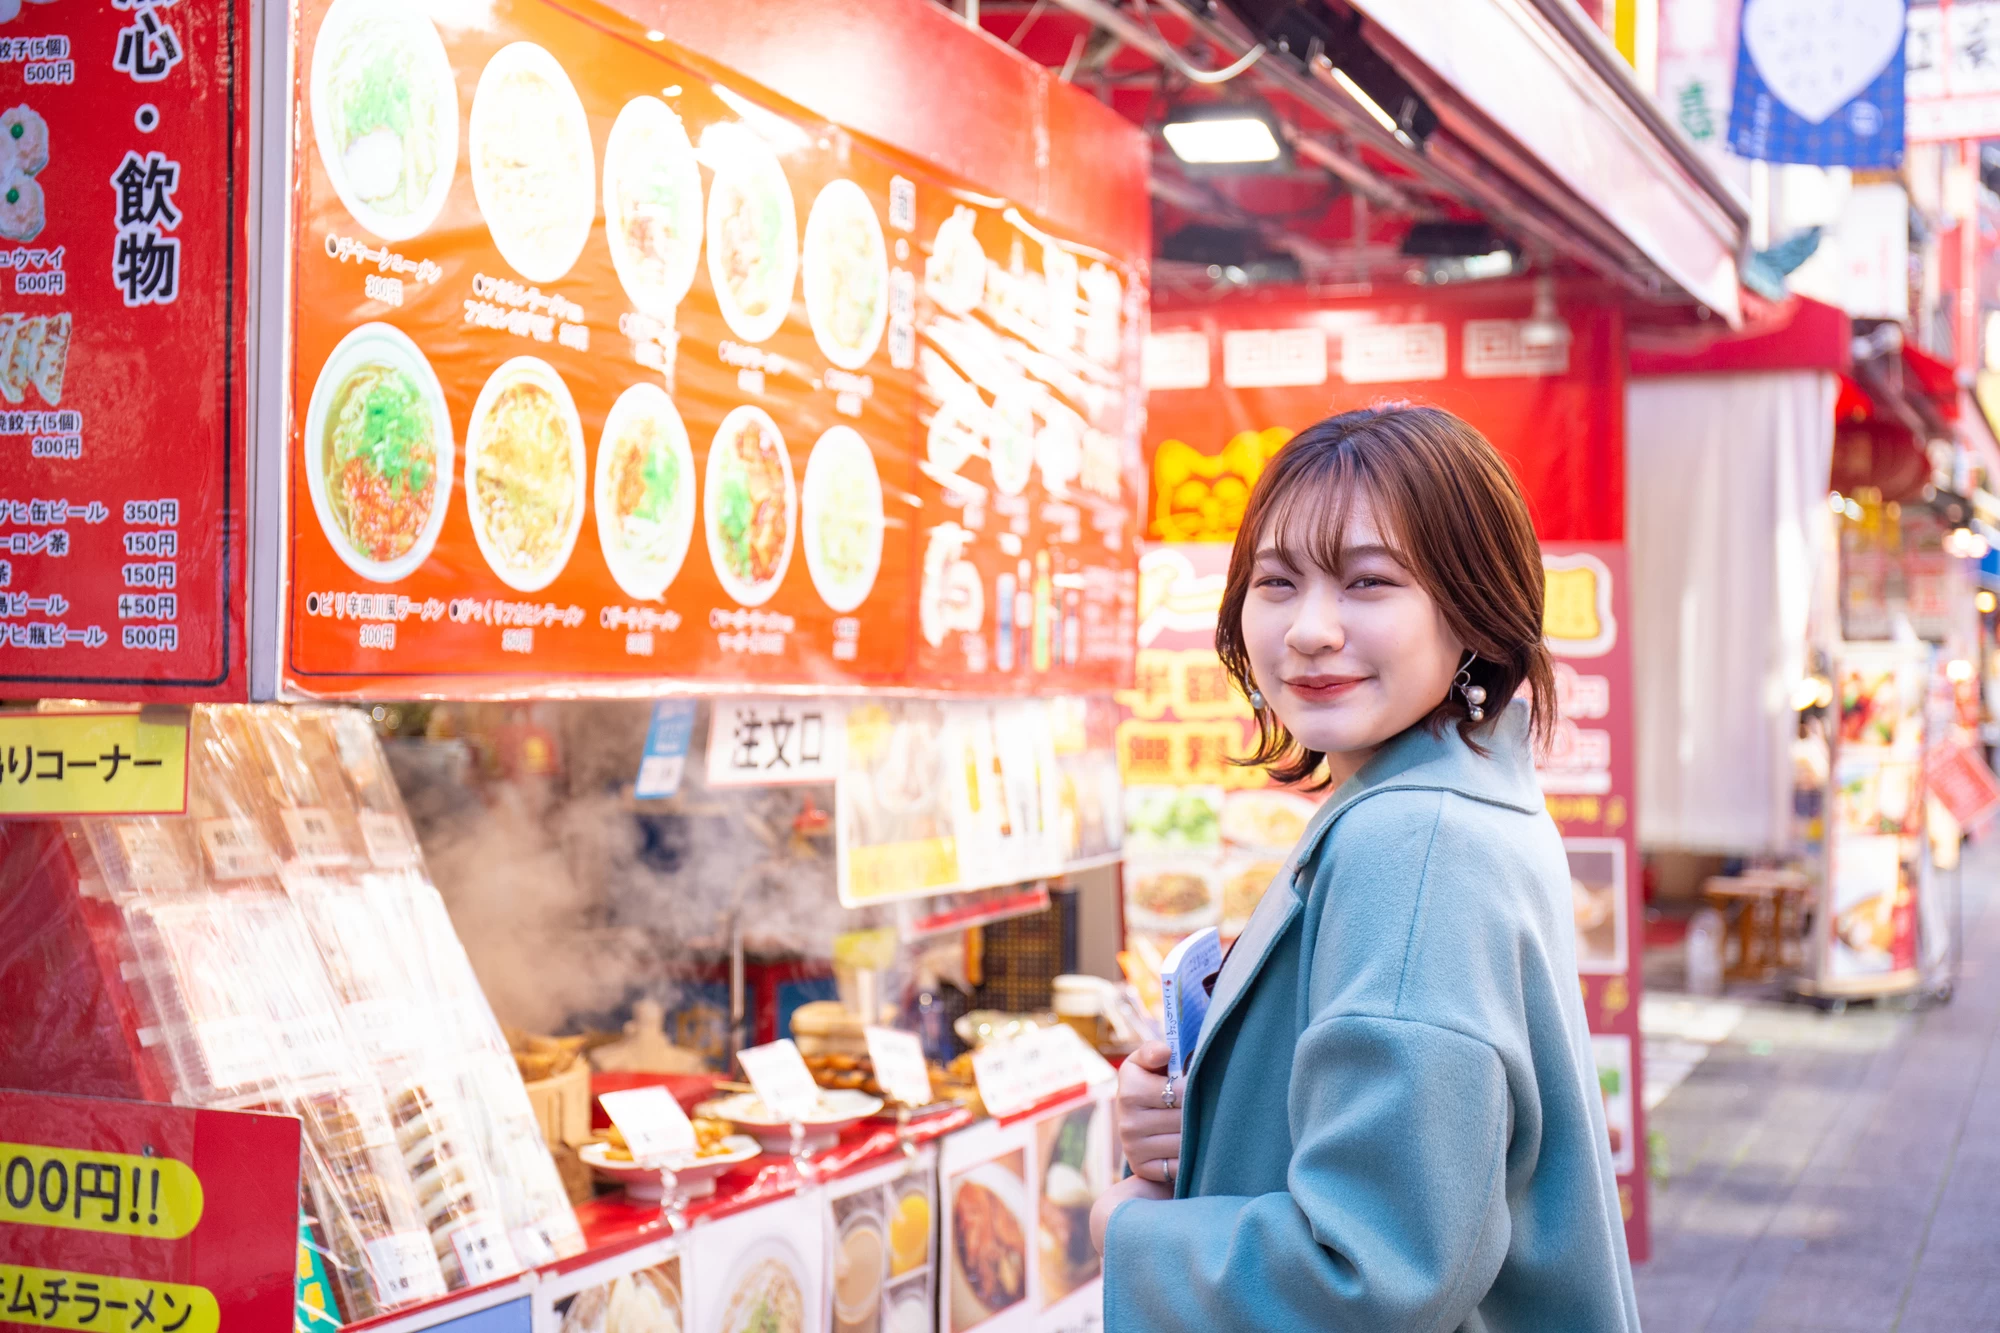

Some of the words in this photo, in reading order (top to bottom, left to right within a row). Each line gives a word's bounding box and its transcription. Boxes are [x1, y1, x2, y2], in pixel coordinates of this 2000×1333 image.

[27, 63, 71, 81] 500円
[112, 0, 180, 304] 心・飲物
[18, 274, 63, 291] 500円
[34, 437, 79, 455] 300円
[125, 501, 177, 521] 350円
[125, 535, 175, 553] 150円
[124, 566, 174, 585] 150円
[120, 596, 175, 618] 450円
[125, 628, 176, 647] 500円
[732, 708, 824, 769] 注文口
[0, 744, 162, 784] りコーナー
[0, 1155, 160, 1225] 00円!!
[0, 1274, 192, 1332] ムチラーメン
